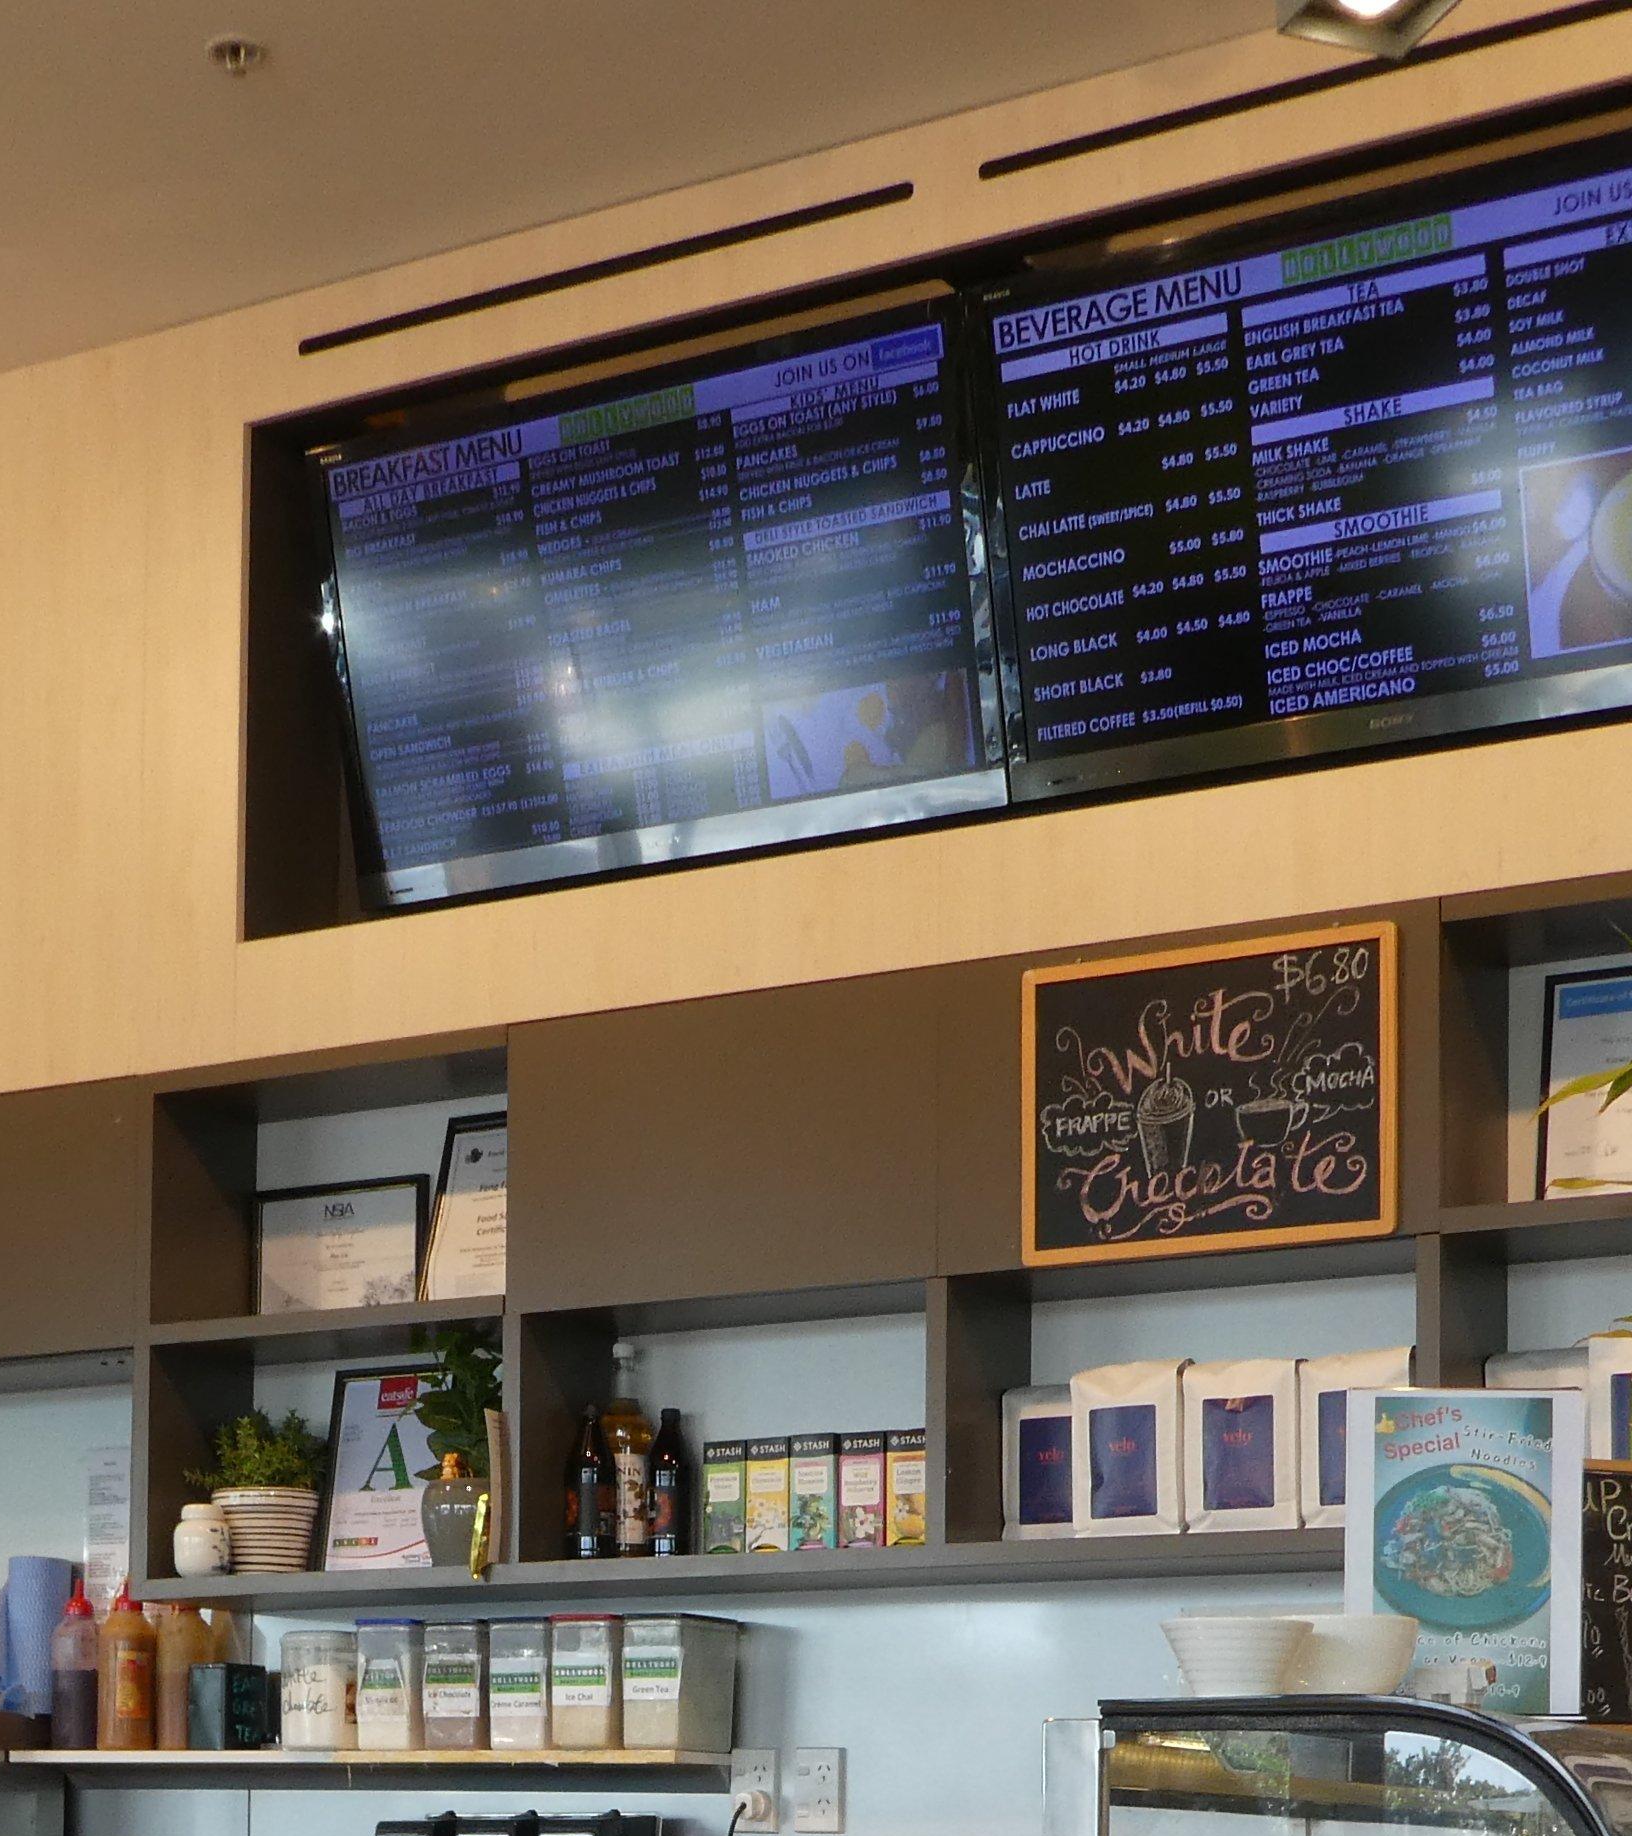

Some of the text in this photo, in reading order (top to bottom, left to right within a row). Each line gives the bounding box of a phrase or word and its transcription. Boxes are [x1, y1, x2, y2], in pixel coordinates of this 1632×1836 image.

[1553, 186, 1603, 216] JOIN
[1608, 179, 1632, 203] US
[1347, 279, 1379, 303] TEA
[998, 265, 1242, 349] BEVERAGE MENU
[1243, 297, 1404, 348] ENGLISH BREAKFAST TEA
[1069, 329, 1160, 366] HOT DRINK
[1245, 336, 1345, 371] EARL GREY TEA
[773, 363, 813, 388] JOIN
[818, 357, 837, 378] US
[842, 350, 869, 372] ON
[1248, 366, 1319, 395] GREEN TEA
[834, 376, 879, 399] MENU
[1006, 389, 1080, 419] FLAT WHITE
[1249, 394, 1303, 420] VARIETY
[1343, 397, 1402, 426] SHAKE
[735, 444, 797, 470] PANCAKES
[1010, 426, 1105, 460] CAPPUCCINO
[1251, 437, 1329, 466] MILK SHAKE
[332, 429, 523, 497] BREAKFAST MENU
[738, 478, 790, 502] CHICKEN
[793, 466, 847, 490] NUGGETS
[862, 455, 897, 475] CHIPS
[1014, 478, 1051, 500] LATTE
[741, 505, 764, 521] FISH
[778, 495, 812, 513] CHIPS
[1255, 496, 1341, 528] THICK SHAKE
[1333, 504, 1428, 538] SMOOTHIE
[1018, 521, 1050, 541] CHAI
[1052, 514, 1086, 535] LATTE
[1021, 547, 1126, 583] MOCHACCINO
[1257, 547, 1333, 576] SMOOTHIE
[1026, 590, 1125, 622] HOT CHOCOLATE
[1261, 585, 1312, 609] FRAPPE
[1030, 642, 1069, 662] LONG
[1073, 633, 1118, 654] BLACK
[1265, 639, 1299, 659] ICED
[1302, 628, 1362, 653] MOCHA
[1267, 665, 1301, 685] ICED
[1304, 646, 1413, 678] CHOC/COFFEE
[1033, 682, 1075, 702] SHORT
[1079, 673, 1124, 694] BLACK
[1269, 695, 1308, 715] ICED
[1311, 677, 1416, 708] AMERICANO
[1036, 720, 1086, 742] FILTERED
[1088, 711, 1136, 733] COFFEE
[1273, 947, 1369, 1001] $6.80
[1056, 989, 1274, 1094] White
[1055, 1068, 1374, 1137] FRAPPE OR MOCHA
[1059, 1131, 1367, 1224] Chocolate
[1395, 1407, 1462, 1430] Chef's
[359, 1423, 413, 1491] A
[716, 1447, 742, 1457] STASH
[760, 1444, 786, 1454] STASH
[803, 1440, 829, 1450] STASH
[853, 1439, 880, 1449] STASH
[1384, 1432, 1460, 1460] Special
[1471, 1449, 1537, 1470] Noodles
